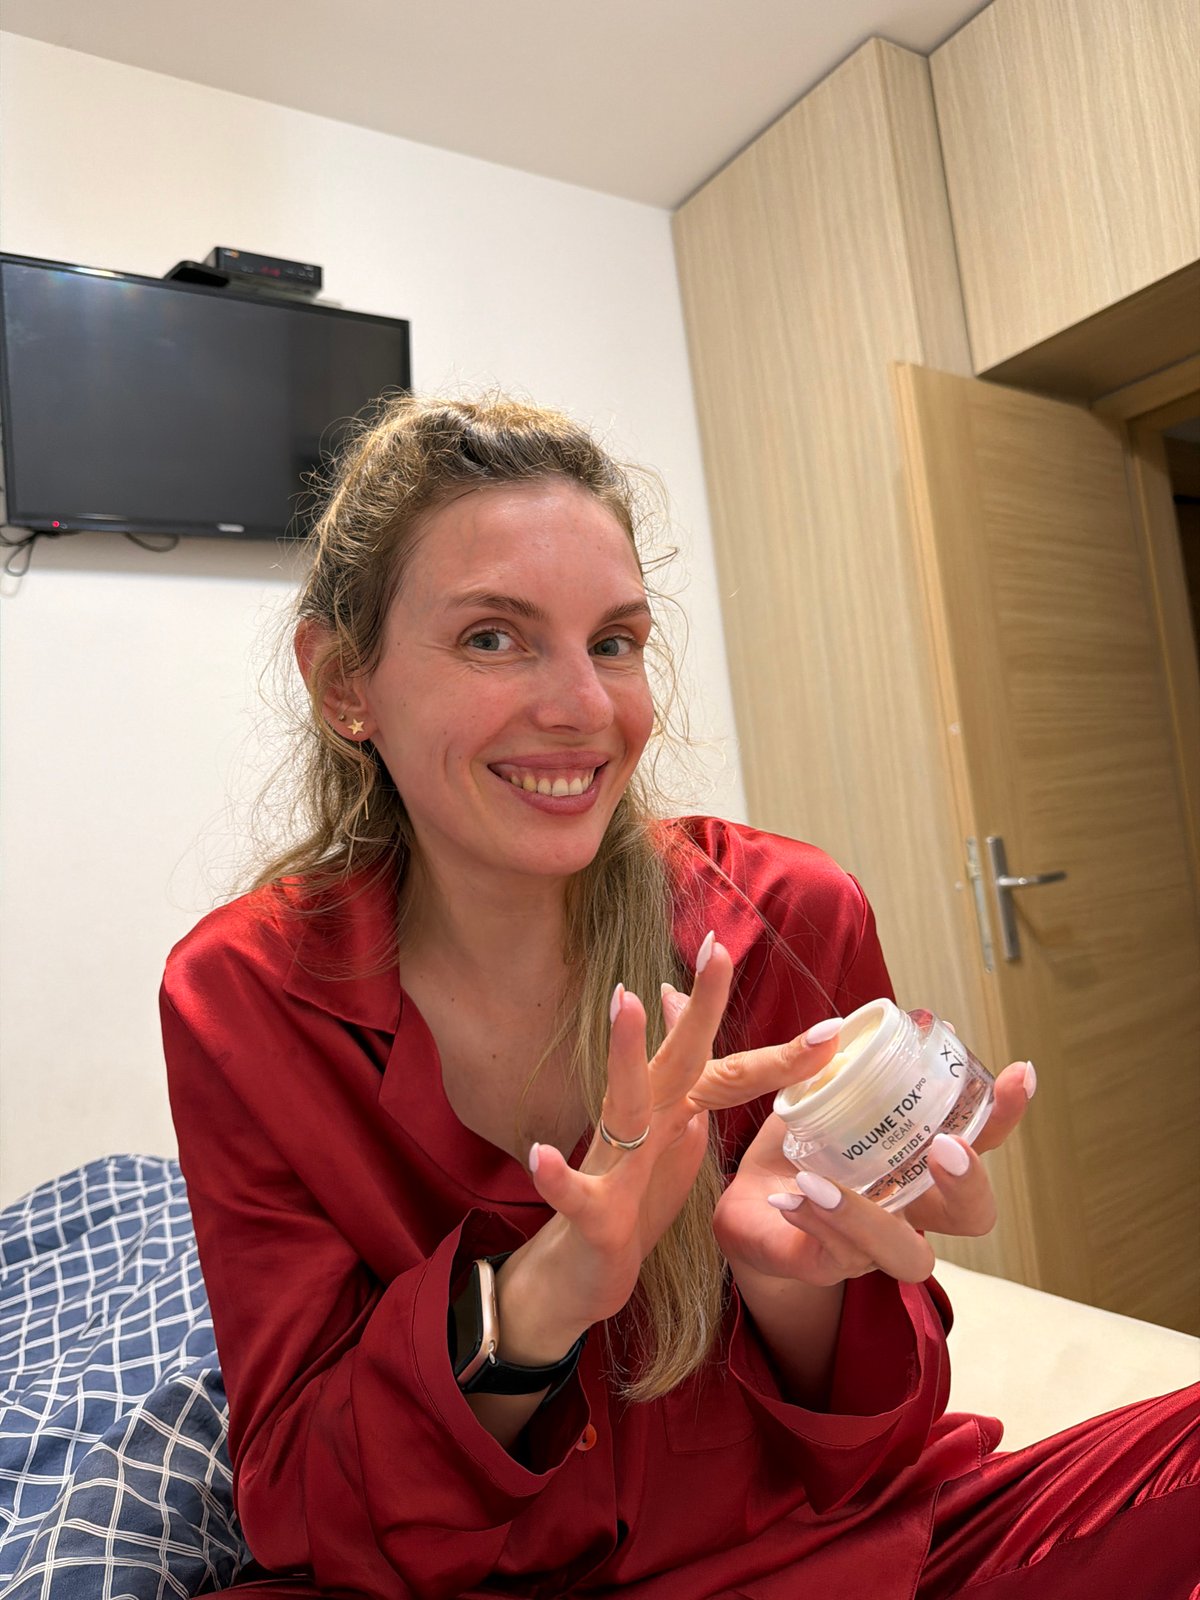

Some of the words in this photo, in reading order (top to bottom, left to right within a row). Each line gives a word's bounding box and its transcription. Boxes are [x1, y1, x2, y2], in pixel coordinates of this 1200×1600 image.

[842, 1116, 898, 1161] VOLUME
[893, 1089, 922, 1118] TOX
[915, 1077, 927, 1092] pro
[881, 1118, 915, 1150] CREAM
[887, 1133, 925, 1167] PEPTIDE
[923, 1125, 931, 1134] 9
